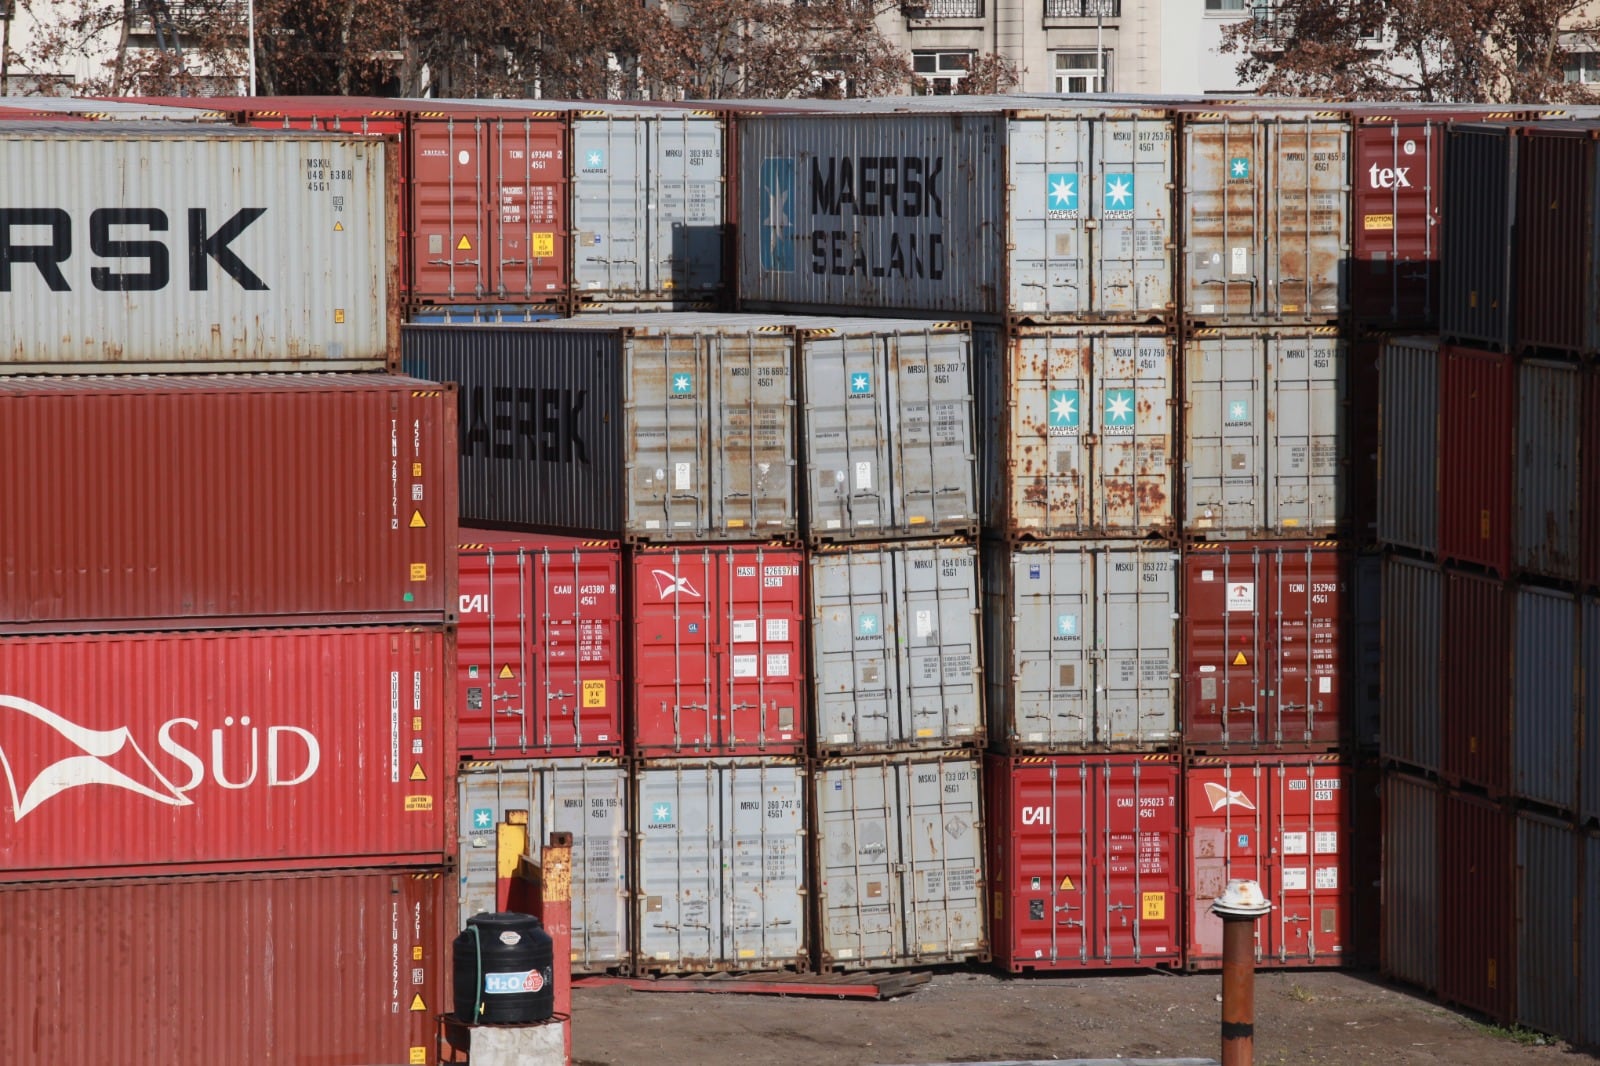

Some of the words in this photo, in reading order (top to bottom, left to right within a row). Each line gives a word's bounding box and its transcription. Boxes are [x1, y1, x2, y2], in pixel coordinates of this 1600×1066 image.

[1113, 132, 1132, 141] MSKU
[1138, 132, 1150, 141] 917
[1138, 143, 1154, 152] 45G1
[665, 150, 682, 158] MRKU
[531, 161, 546, 169] 45G1
[1314, 163, 1330, 171] 45G1
[1368, 162, 1411, 189] tex
[307, 182, 330, 191] 45G1
[812, 156, 944, 218] MAERSK
[812, 230, 944, 280] SEALAND
[1114, 348, 1132, 357] MSKU
[1139, 348, 1151, 357] 847
[1153, 348, 1165, 357] 750
[1287, 350, 1305, 358] MRKU
[1314, 350, 1326, 358] 325
[1141, 360, 1156, 368] 45G1
[1314, 359, 1328, 368] 45G1
[758, 367, 770, 376] 316
[908, 365, 926, 374] MRSU
[947, 363, 958, 372] 207
[758, 378, 773, 387] 45G1
[934, 375, 949, 384] 45G1
[914, 560, 932, 569] MRKU
[942, 560, 953, 568] 454
[1116, 563, 1134, 572] MSKU
[1143, 563, 1154, 572] 053
[1156, 563, 1167, 571] 222
[737, 568, 755, 576] HASU
[942, 568, 957, 577] 45G1
[765, 578, 782, 586] 45G1
[1143, 573, 1158, 582] 45G1
[554, 586, 572, 594] CAAU
[581, 585, 604, 594] 643380
[1289, 584, 1304, 592] TCNU
[1313, 584, 1336, 592] 352960
[581, 596, 596, 605] 45G1
[1312, 594, 1328, 603] 45G1
[459, 595, 488, 613] CAI
[158, 716, 320, 792] SÜD
[918, 775, 937, 784] MSKU
[958, 772, 969, 781] 021
[945, 784, 959, 793] 45G1
[1289, 781, 1306, 789] SUDU
[1315, 790, 1332, 799] 45G1
[741, 802, 759, 810] MRKU
[781, 800, 792, 809] 747
[1117, 799, 1133, 807] CAAU
[1140, 798, 1164, 806] 595023
[592, 809, 607, 818] 45G1
[768, 810, 782, 818] 45G1
[1022, 807, 1050, 825] CAI
[1140, 809, 1155, 817] 45G1
